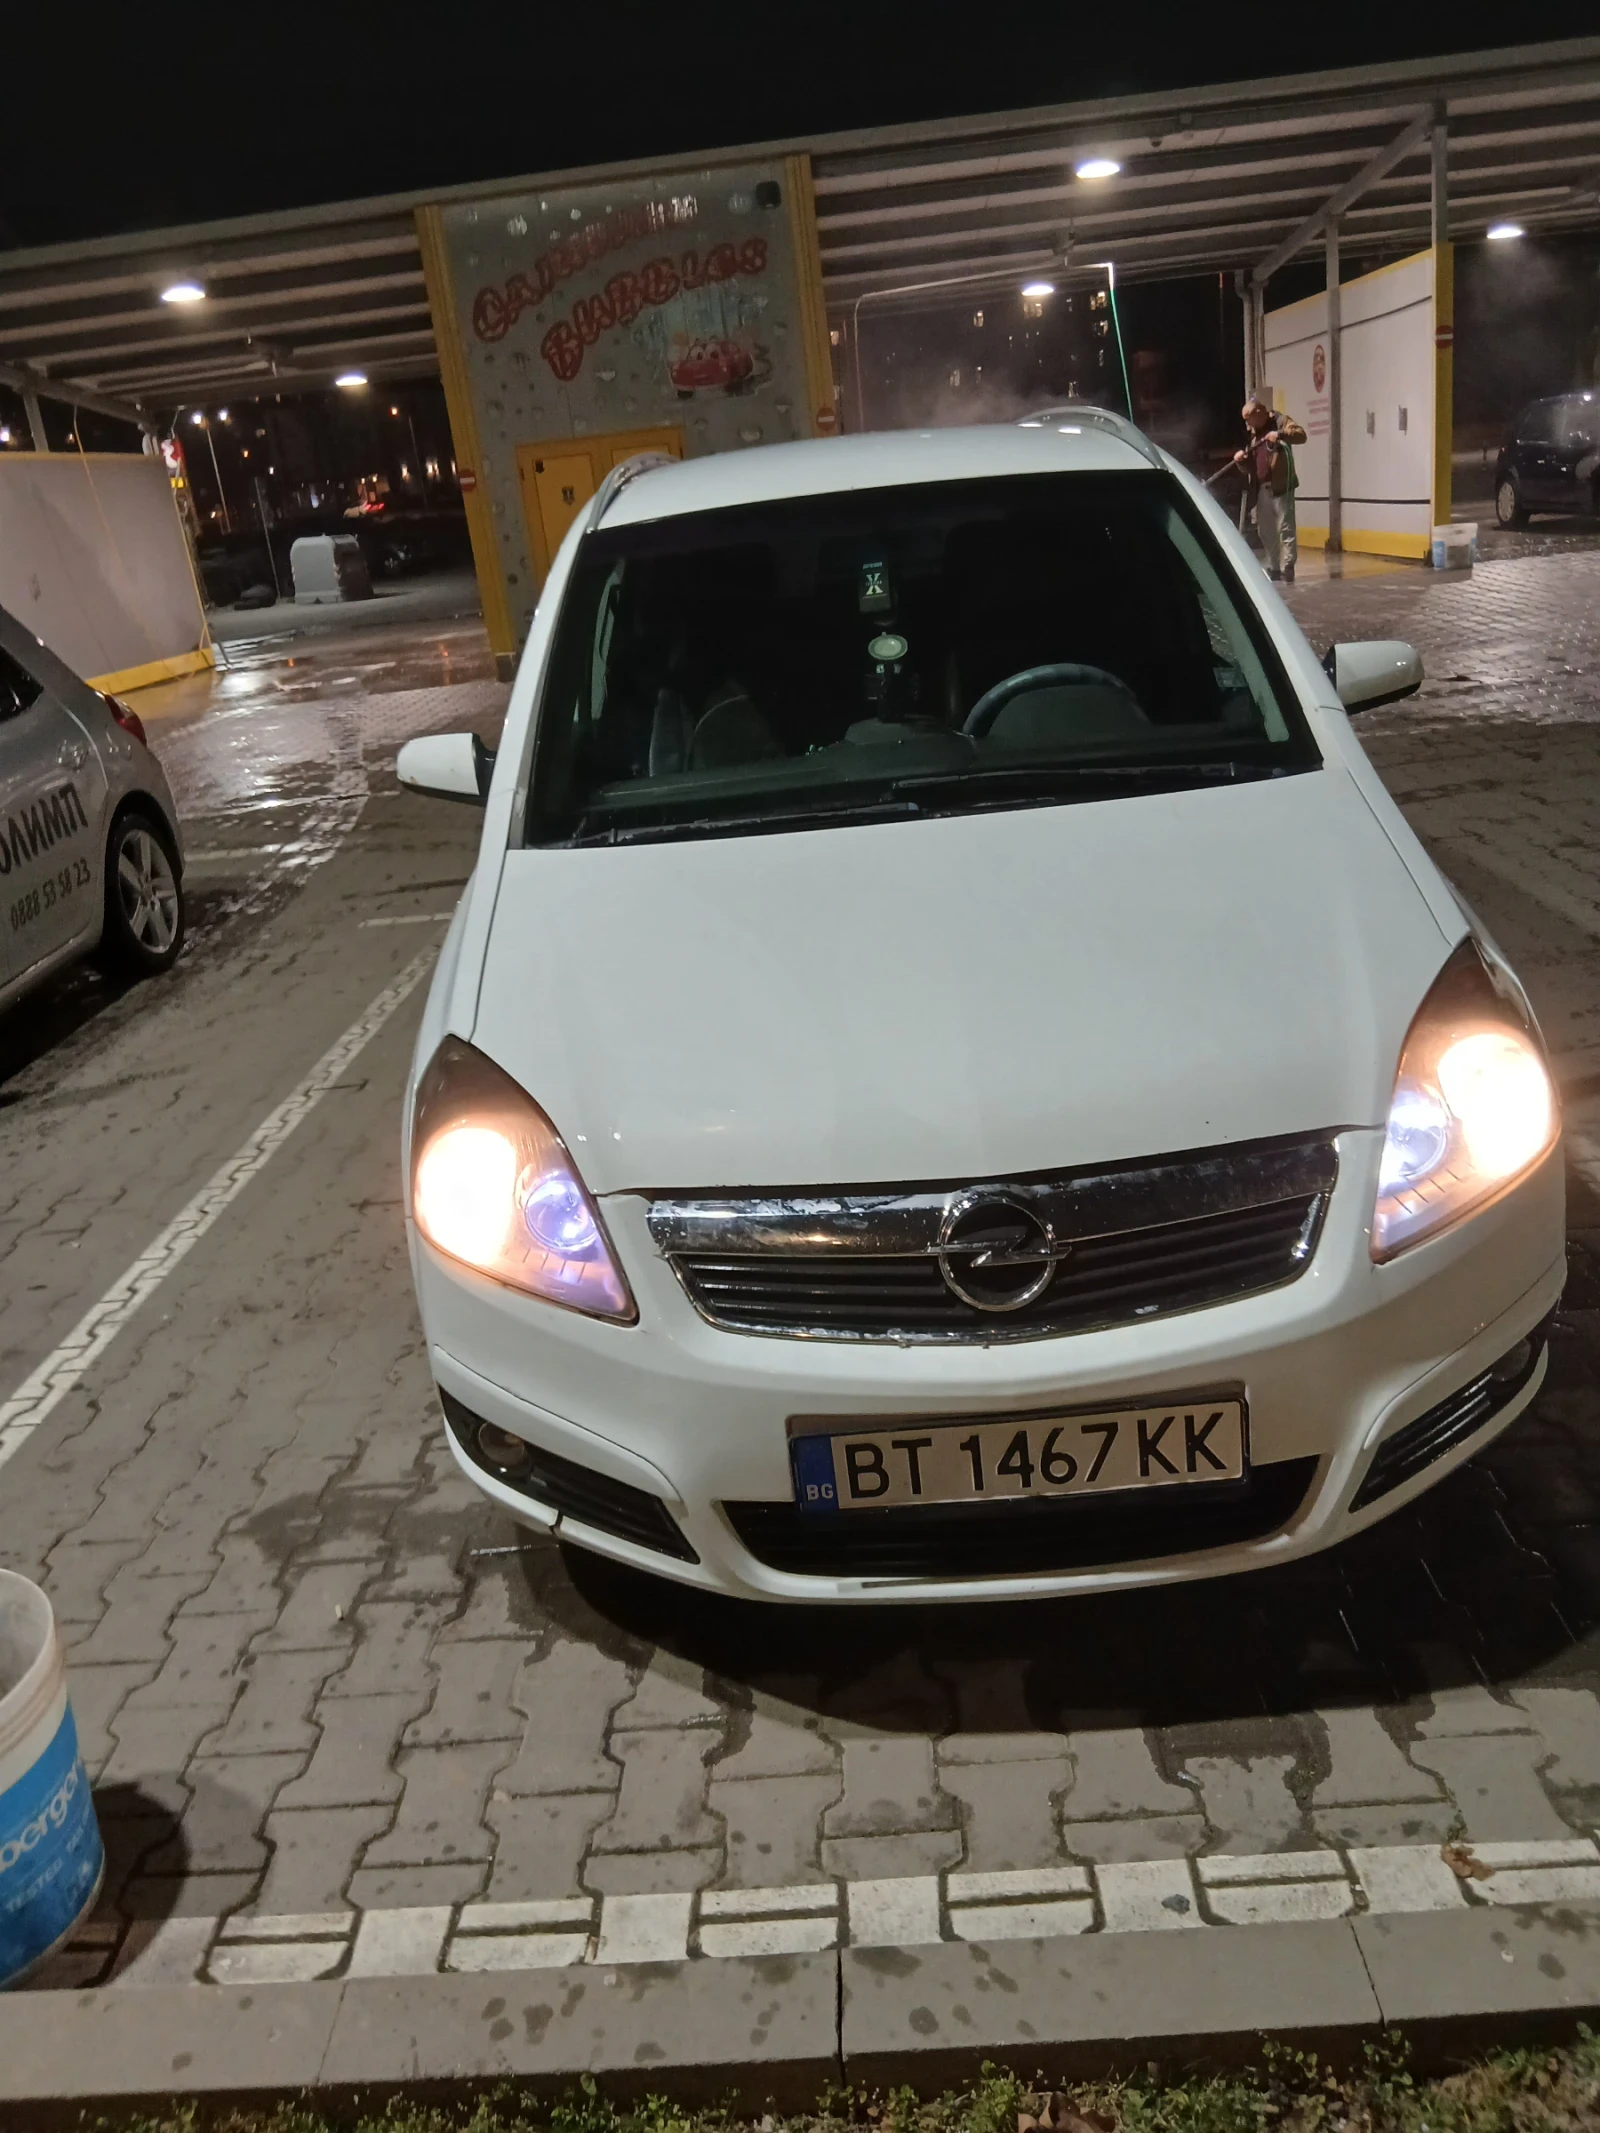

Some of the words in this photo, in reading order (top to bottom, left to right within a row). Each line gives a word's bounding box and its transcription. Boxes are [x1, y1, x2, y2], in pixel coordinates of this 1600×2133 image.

[844, 1437, 932, 1499] BT
[959, 1421, 1119, 1492] 1467
[1136, 1411, 1228, 1478] KK
[806, 1482, 834, 1501] BG
